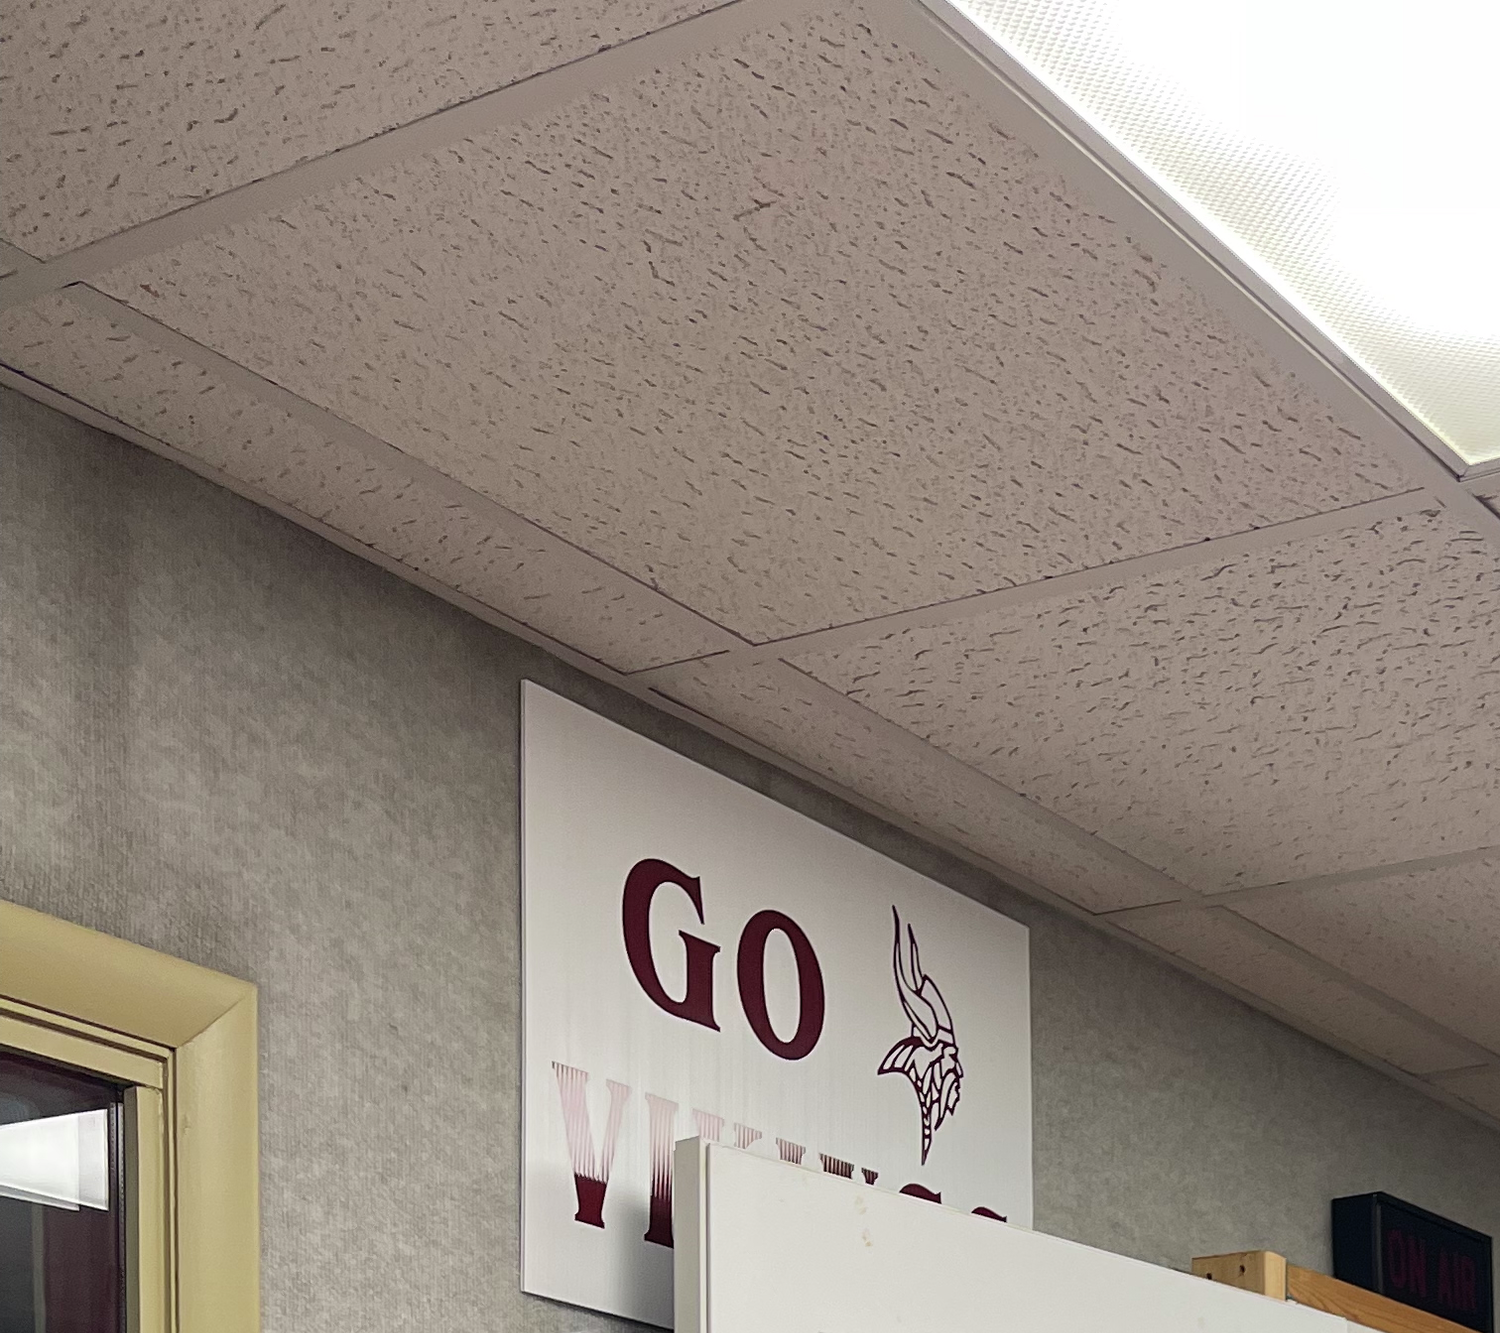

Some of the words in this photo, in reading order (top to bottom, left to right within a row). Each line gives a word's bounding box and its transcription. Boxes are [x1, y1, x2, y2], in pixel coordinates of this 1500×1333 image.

[622, 858, 825, 1061] GO
[1387, 1229, 1427, 1298] ON
[1437, 1247, 1477, 1310] AIR
